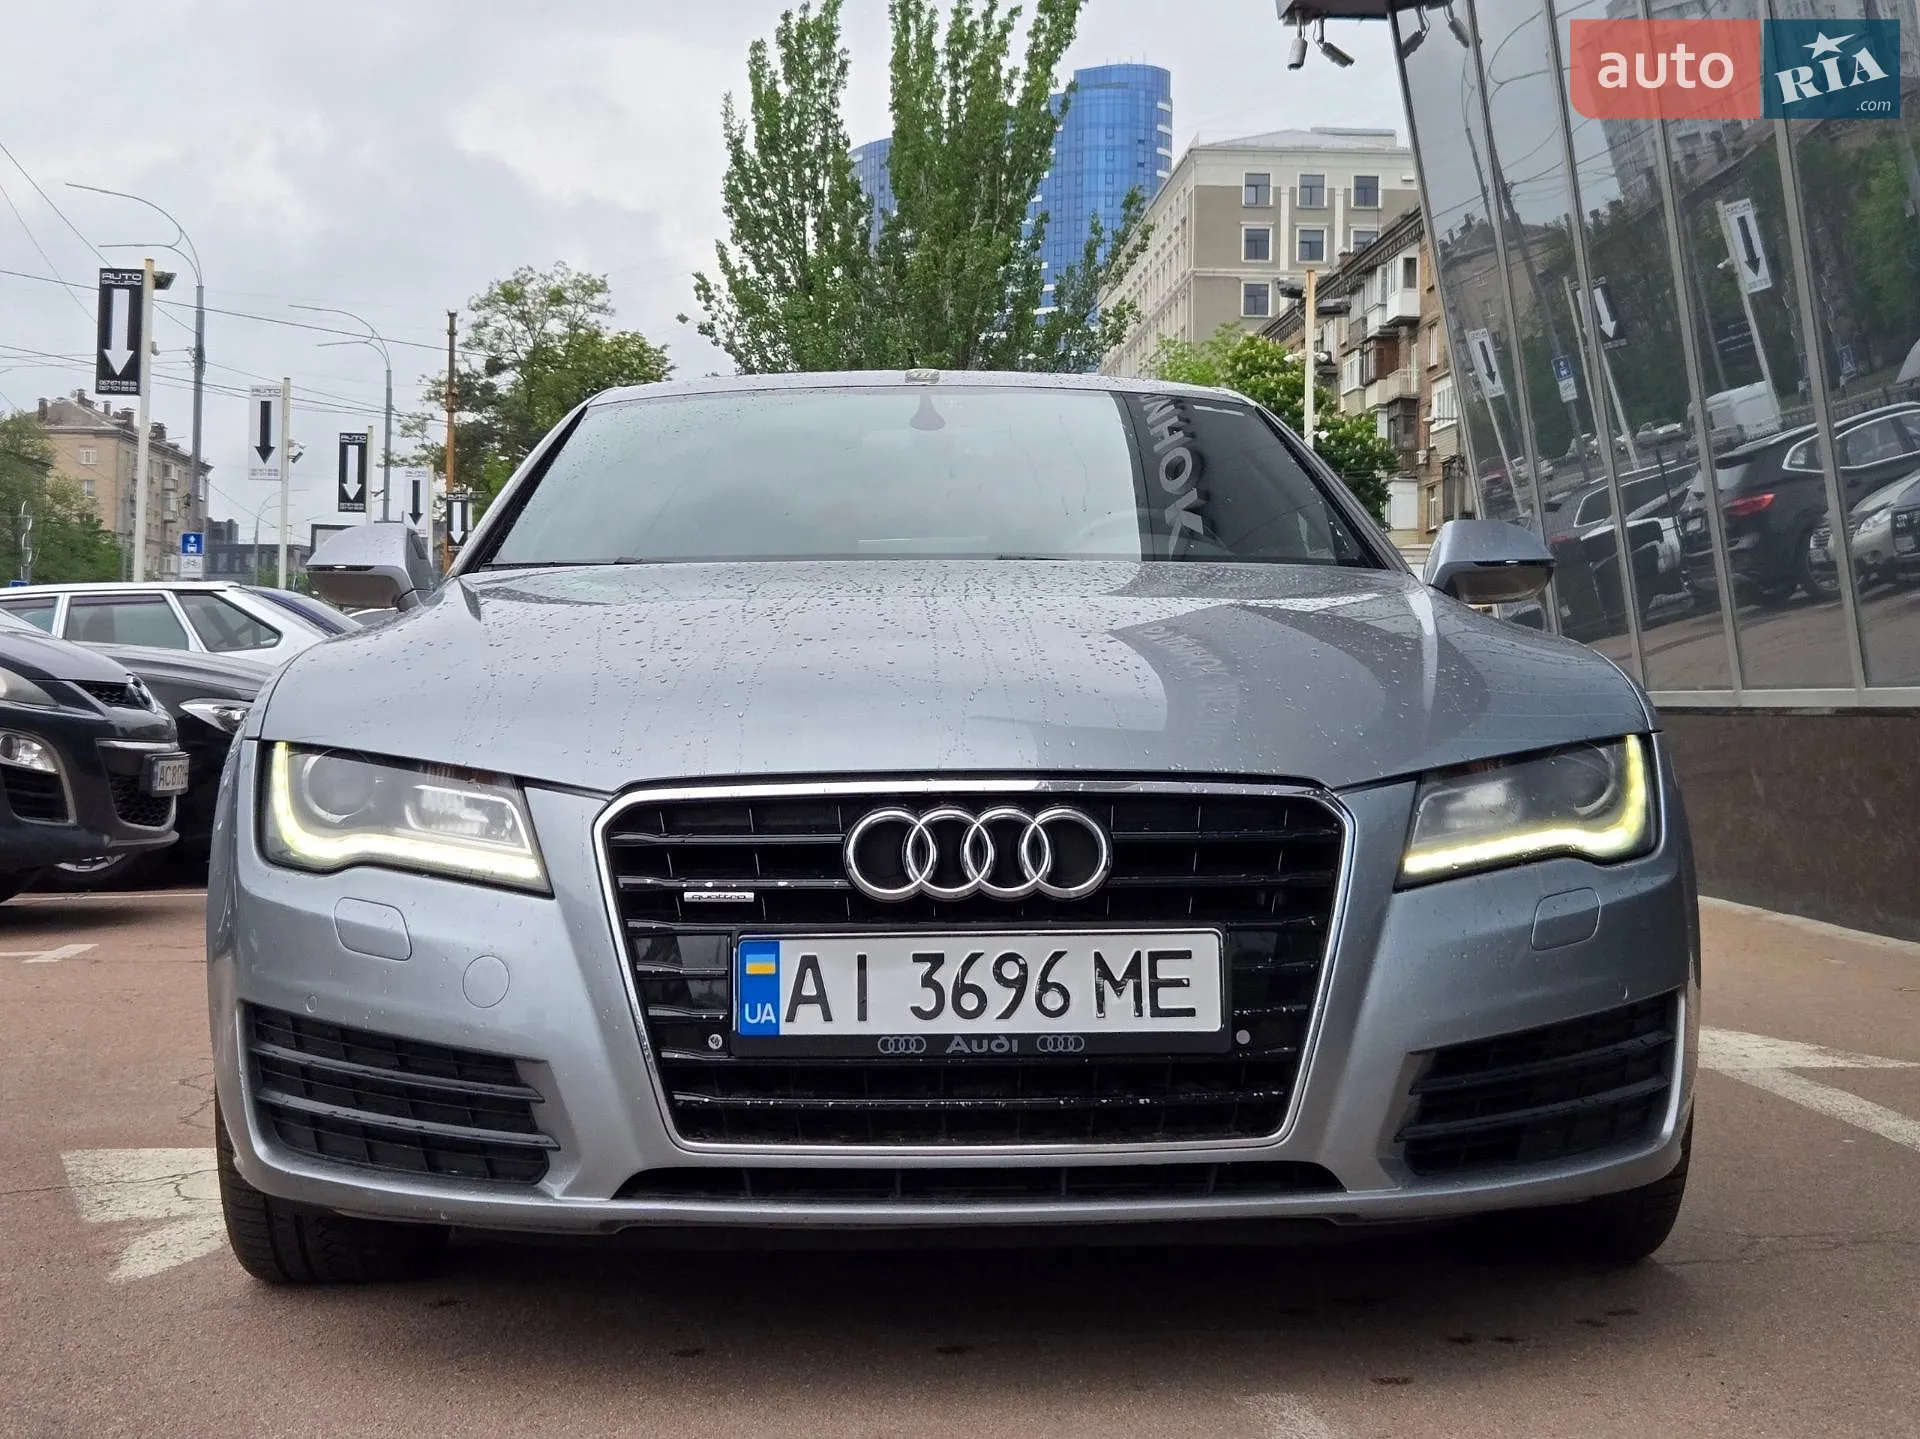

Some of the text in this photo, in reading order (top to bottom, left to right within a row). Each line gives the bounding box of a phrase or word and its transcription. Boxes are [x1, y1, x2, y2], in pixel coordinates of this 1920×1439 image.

[102, 272, 142, 280] AUTO
[784, 949, 1197, 1023] AI 3696 ME
[744, 1002, 777, 1024] UA
[945, 1034, 1019, 1054] Audi
